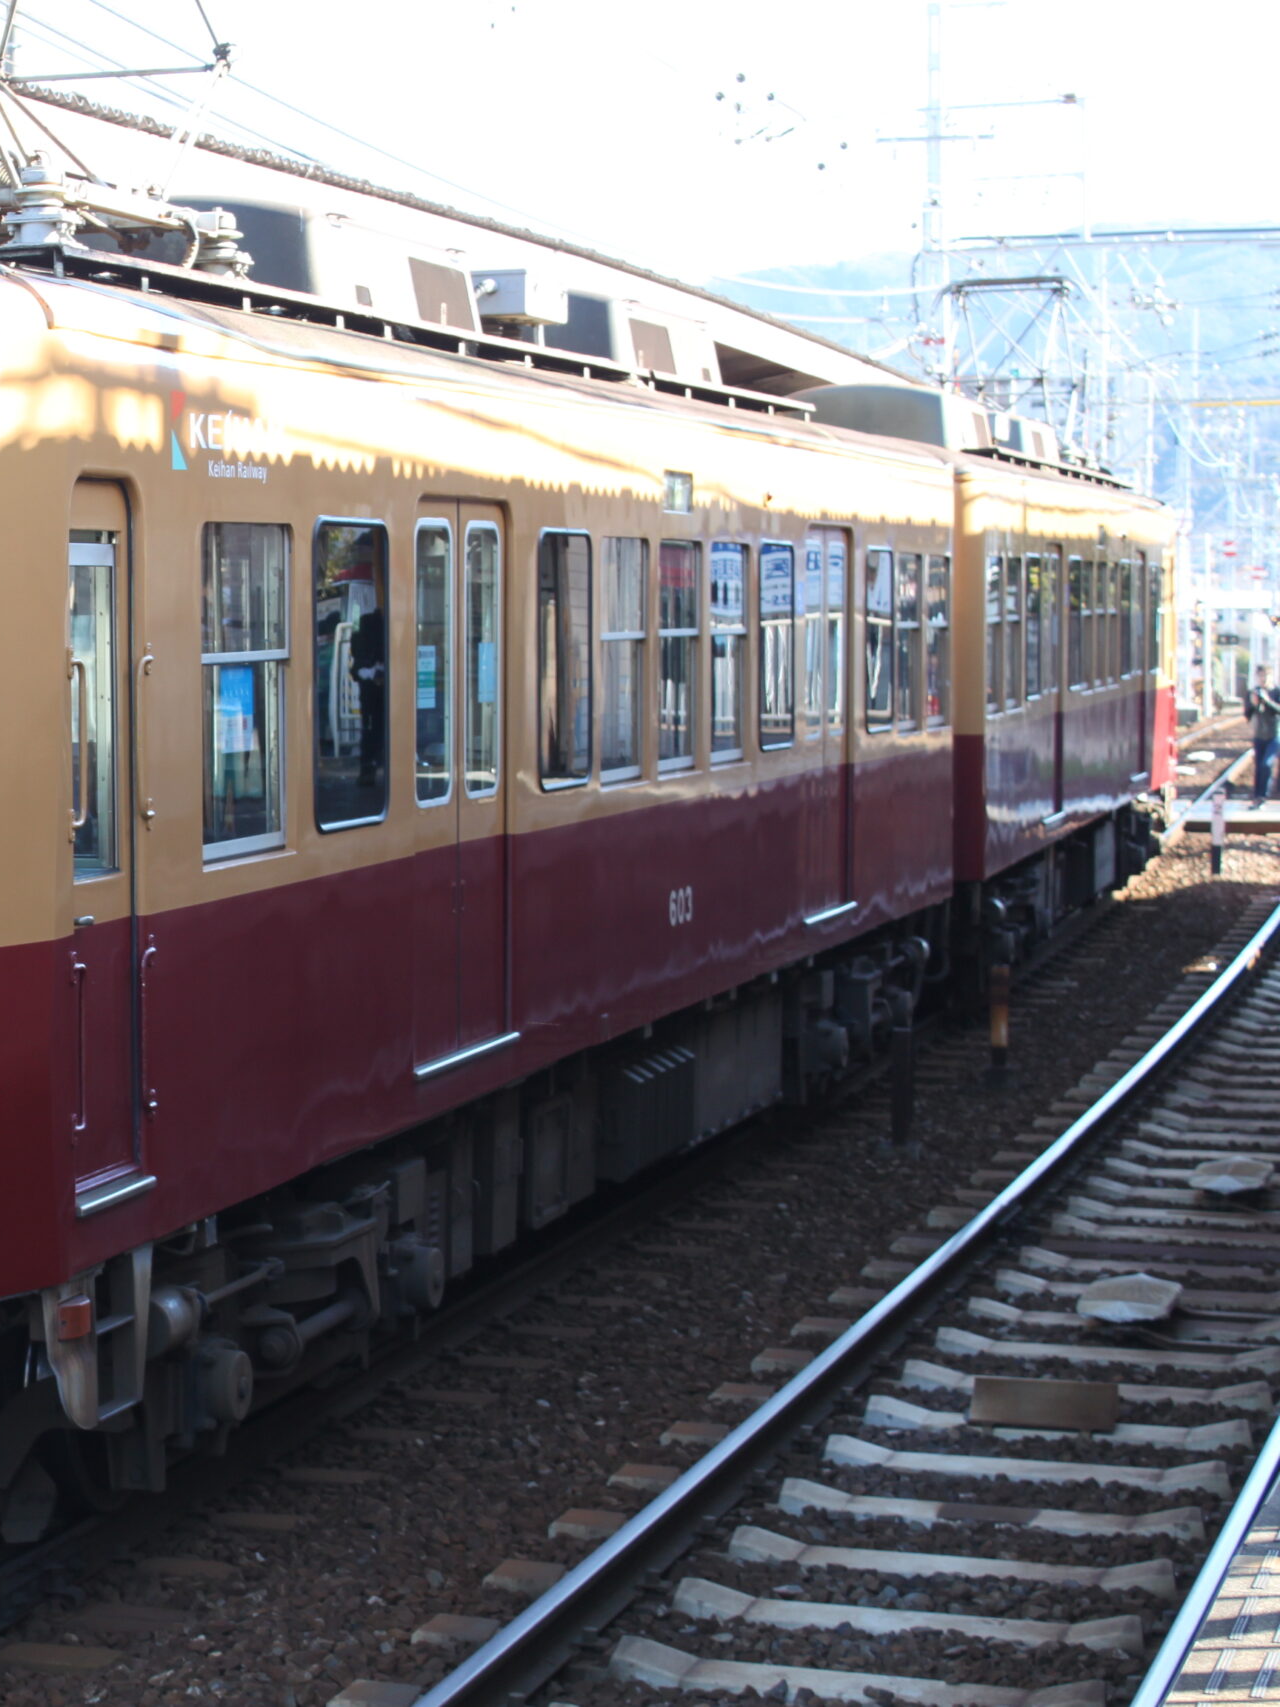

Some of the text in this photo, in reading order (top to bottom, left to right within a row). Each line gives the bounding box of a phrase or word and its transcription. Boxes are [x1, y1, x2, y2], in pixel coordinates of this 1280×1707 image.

[208, 459, 268, 484] Keihan Railway
[668, 884, 694, 927] 603
